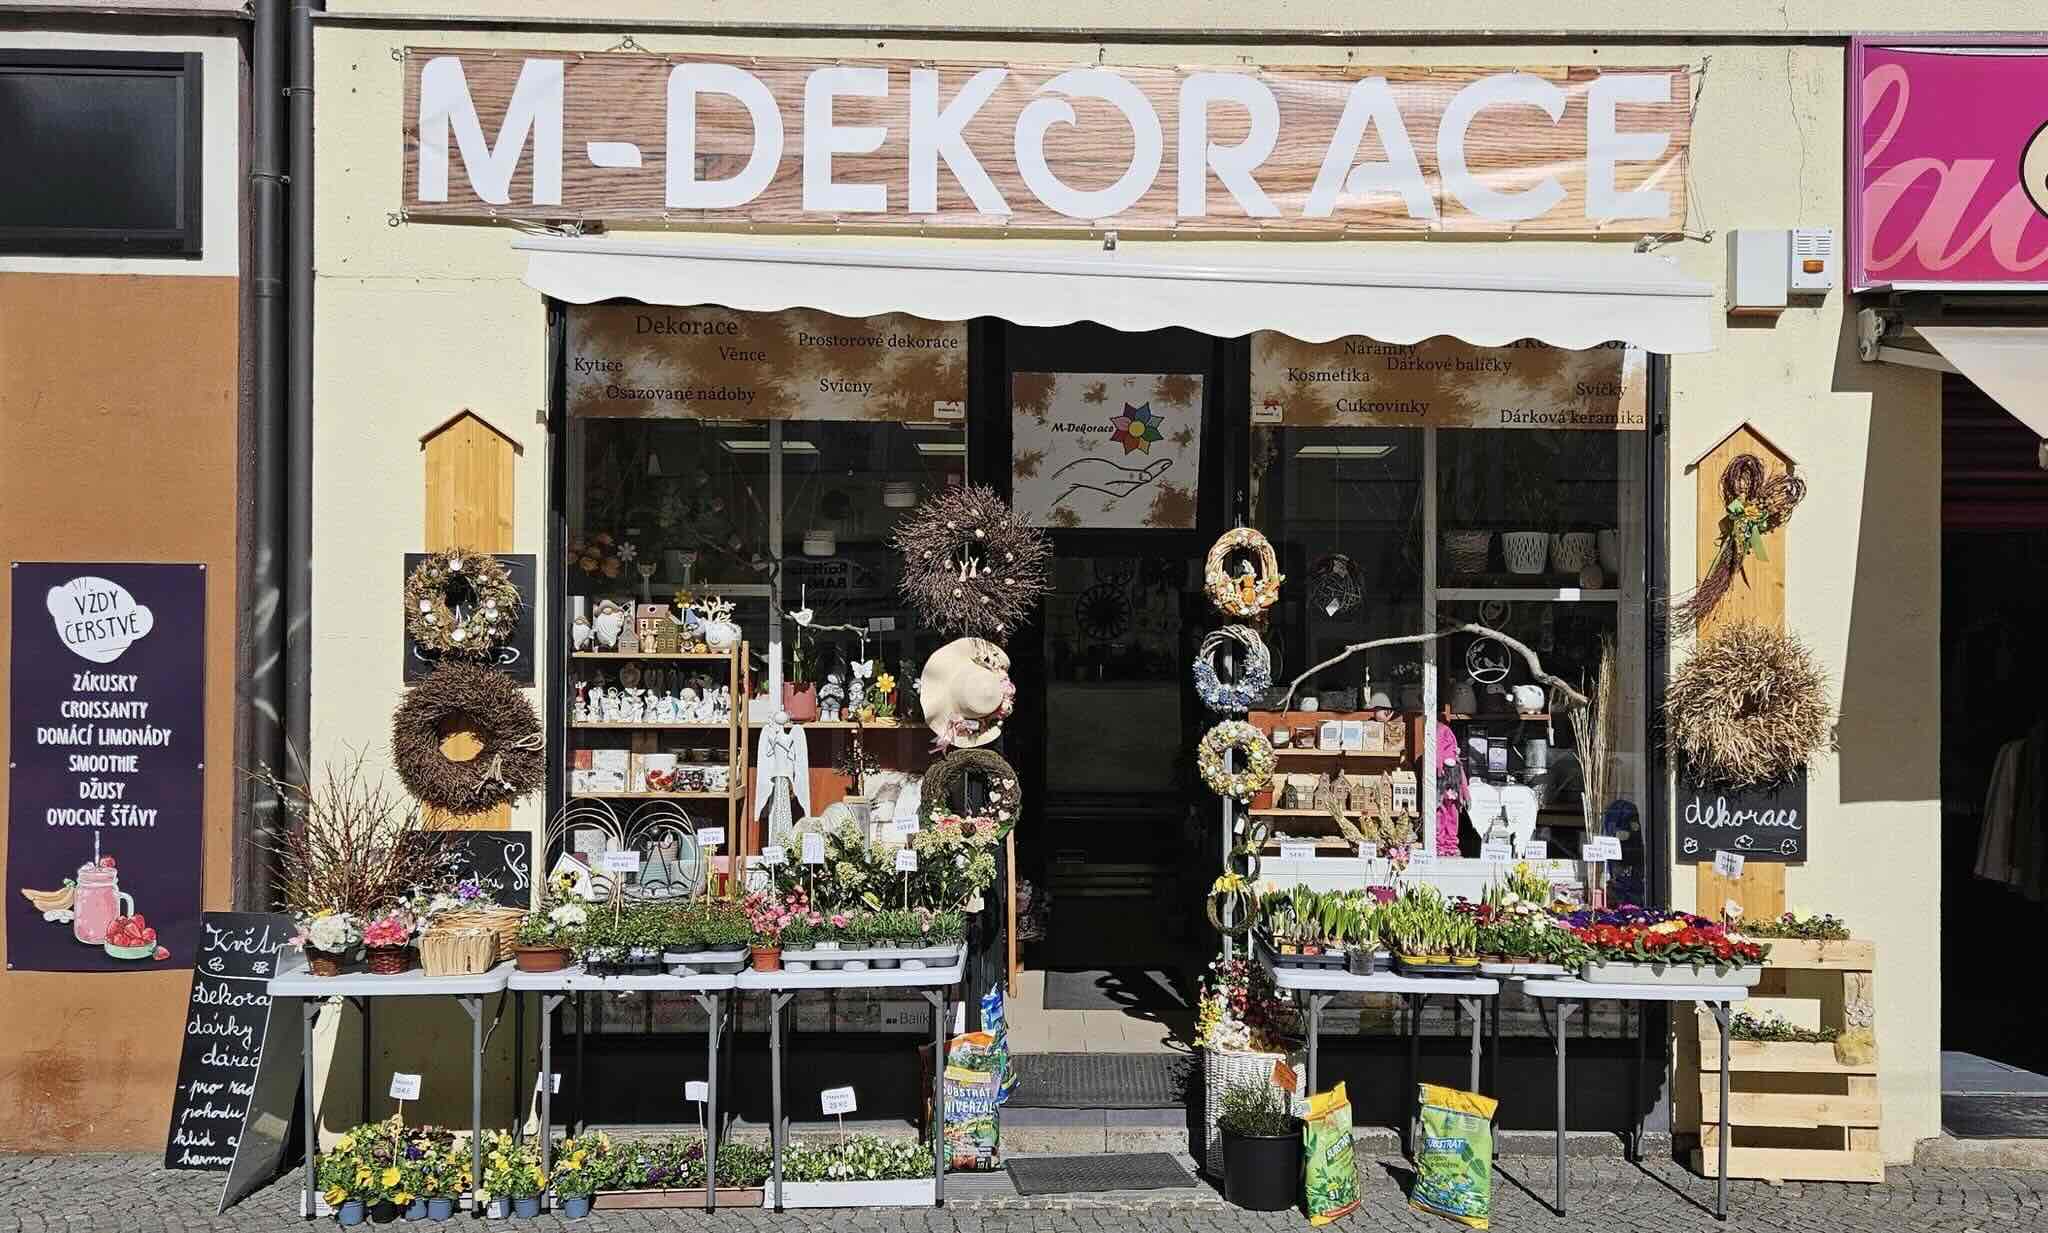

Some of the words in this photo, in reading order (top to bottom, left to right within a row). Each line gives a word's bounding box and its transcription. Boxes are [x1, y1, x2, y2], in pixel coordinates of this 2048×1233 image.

[636, 315, 738, 336] Dekorace
[799, 332, 884, 348] Prostorové
[887, 333, 958, 350] dekorace
[719, 344, 767, 362] Věnce
[1387, 355, 1452, 372] Dárkové
[574, 357, 624, 376] Kytice
[1288, 367, 1371, 384] Kosmetika
[605, 384, 694, 401] Osazované
[697, 385, 756, 405] nádoby
[1336, 398, 1431, 416] Cukrovinky
[1500, 408, 1567, 425] Dárková
[1570, 409, 1644, 425] keramika
[74, 588, 119, 616] VŽDY
[64, 610, 140, 645] ČERSTVÉ
[72, 670, 138, 692] ZÁKUSKY
[61, 700, 149, 719] CROISSANTY
[37, 723, 95, 745] DOMÁCÍ
[98, 724, 172, 746] LIMONÁDY
[69, 754, 139, 772] SMOOTHIE
[79, 777, 126, 800] DŽUSY
[46, 804, 105, 826] OVOCNÉ
[110, 803, 157, 827] ŠŤÁVY
[1684, 795, 1803, 830] dekorace
[187, 1011, 253, 1051] dárky
[189, 1079, 224, 1101] pro
[173, 1127, 216, 1147] klid
